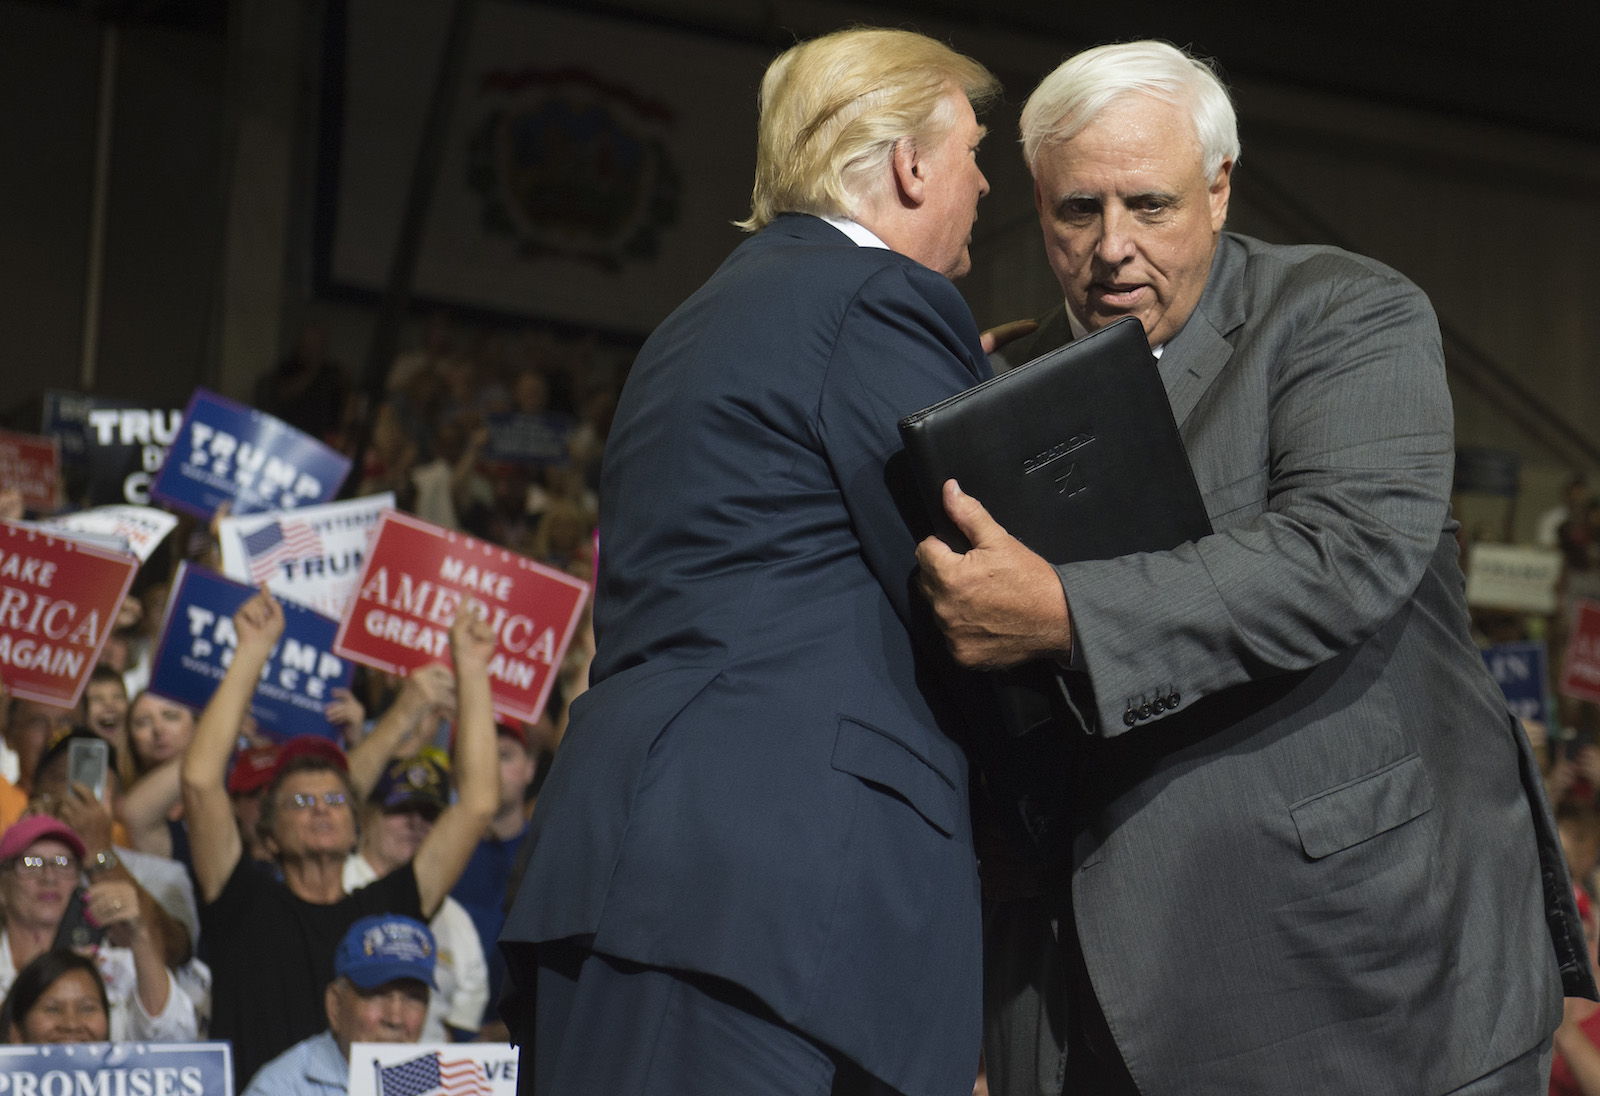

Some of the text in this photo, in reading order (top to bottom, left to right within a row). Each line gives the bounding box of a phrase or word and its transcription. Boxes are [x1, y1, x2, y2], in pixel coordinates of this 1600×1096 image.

[191, 421, 322, 500] TRUMP
[0, 550, 57, 588] AKE
[439, 556, 513, 602] MAKE
[360, 566, 556, 665] AMERICA
[365, 609, 451, 657] GREAT
[0, 633, 84, 679] AGAIN
[187, 604, 343, 681] TRMP
[487, 652, 535, 691] AIN
